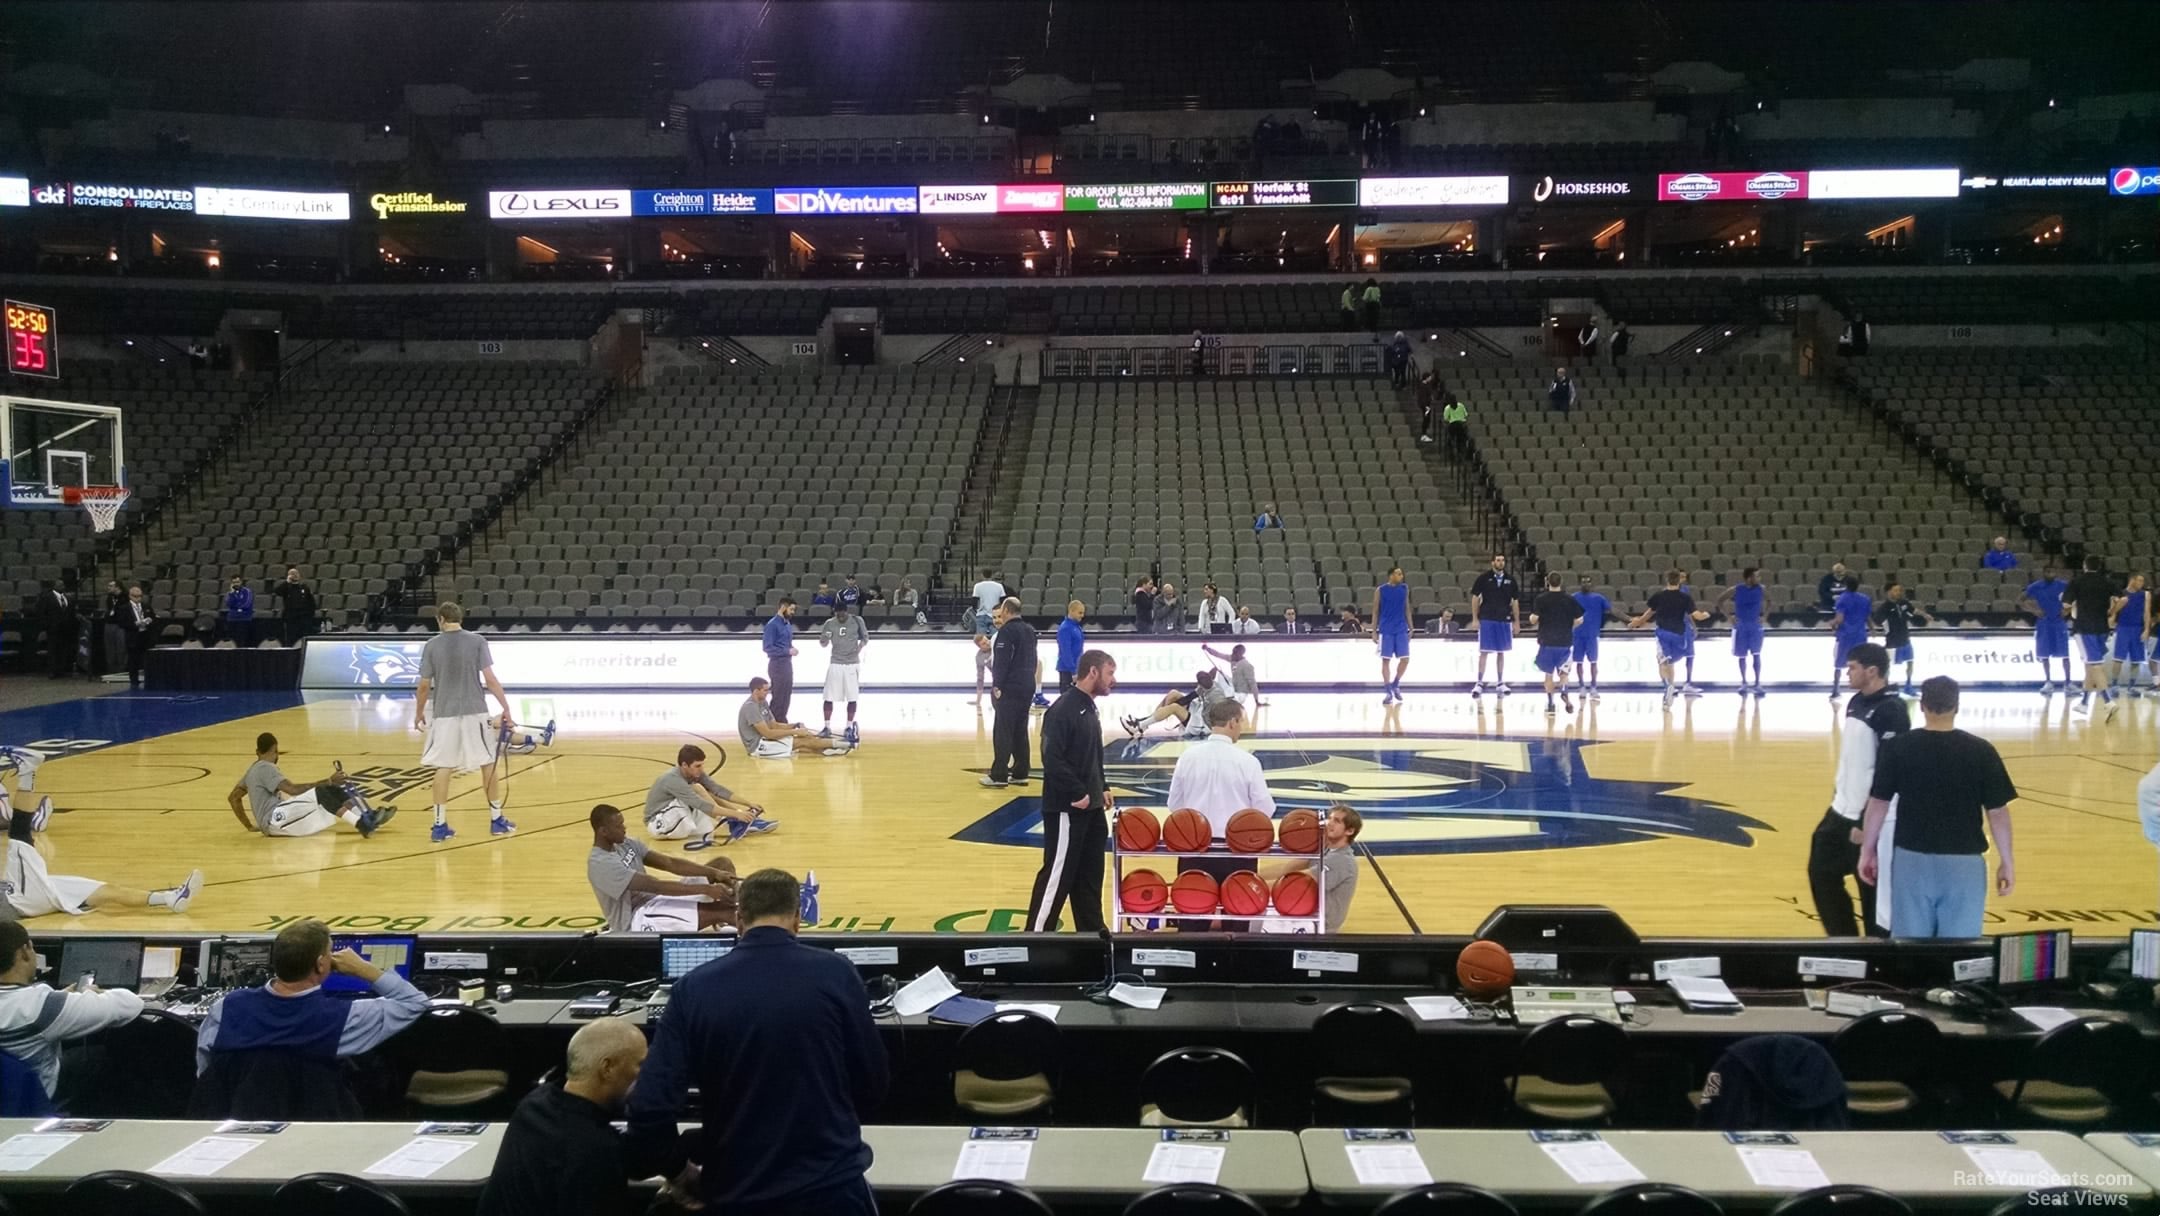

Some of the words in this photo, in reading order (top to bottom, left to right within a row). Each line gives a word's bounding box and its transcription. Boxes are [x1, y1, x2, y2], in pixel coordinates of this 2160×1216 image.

[1216, 185, 1249, 193] NCAAB
[1253, 182, 1294, 194] Norfolk
[1296, 182, 1309, 193] St
[1555, 182, 1630, 195] HORSESHOE
[2003, 178, 2046, 187] HEARTLAND
[2047, 177, 2072, 186] CHEVY
[2073, 177, 2106, 186] DEALERS
[73, 185, 193, 202] CONSOLIDATED
[936, 192, 988, 202] LINDSAY
[1065, 187, 1083, 197] FOR
[1085, 186, 1116, 197] GROUP
[1117, 185, 1145, 197] SALES
[1146, 184, 1205, 196] INFORMATION
[73, 199, 123, 207] KITCHENS
[134, 200, 193, 210] FIREPLACES
[371, 193, 432, 211] Certified
[533, 198, 619, 210] LEXUS
[653, 192, 704, 206] Creighton
[712, 193, 756, 206] Heider
[802, 190, 917, 212] DiVentures
[1097, 198, 1119, 208] CALL
[1253, 193, 1311, 205] Vanderbilt
[241, 197, 334, 215] CenturyLink
[379, 201, 467, 219] Transmission
[8, 308, 47, 333] 52:50
[1952, 327, 1972, 337] 108
[1523, 335, 1543, 345] 106
[15, 332, 44, 369] 35
[481, 343, 500, 353] 103
[794, 344, 814, 354] 104
[564, 653, 678, 668] Ameritrade
[438, 914, 607, 931] onal
[799, 917, 896, 932] Fir
